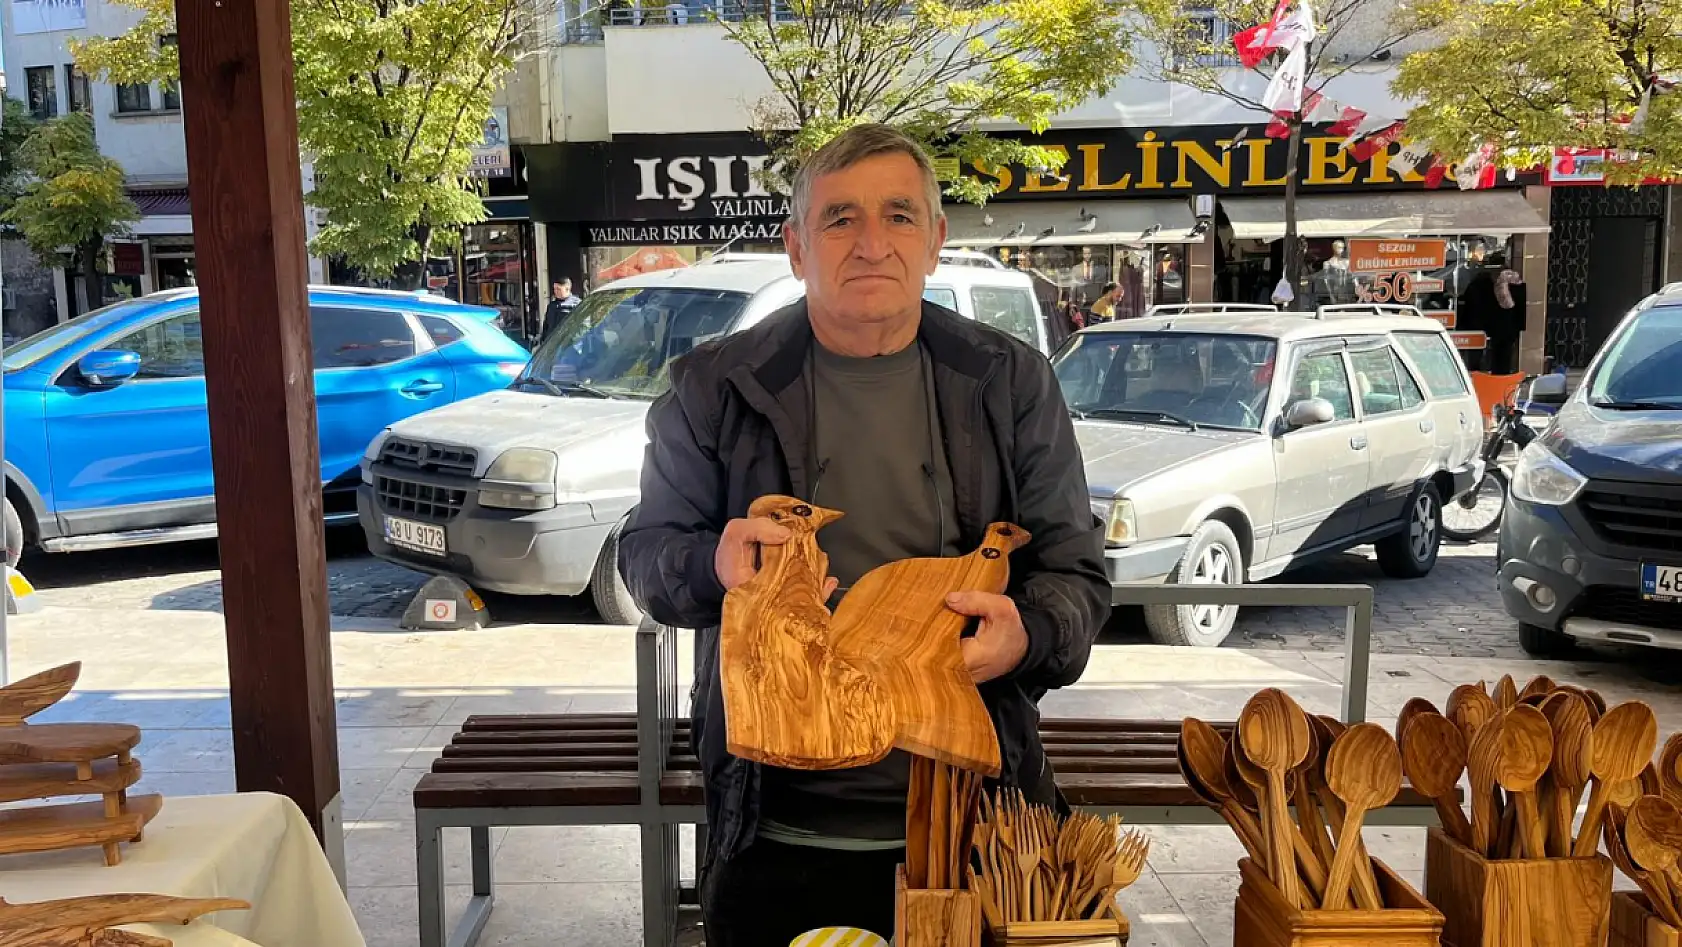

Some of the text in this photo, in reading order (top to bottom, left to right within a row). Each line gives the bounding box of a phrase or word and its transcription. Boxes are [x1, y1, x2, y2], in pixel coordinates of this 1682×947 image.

[711, 200, 791, 217] YALINLA
[589, 221, 782, 244] YALINLAR IŞIK MAĞAZ
[1378, 243, 1415, 253] SEZON
[1357, 257, 1436, 269] ÜRÜNLERİNDE
[404, 523, 412, 541] U
[417, 526, 443, 548] 9173
